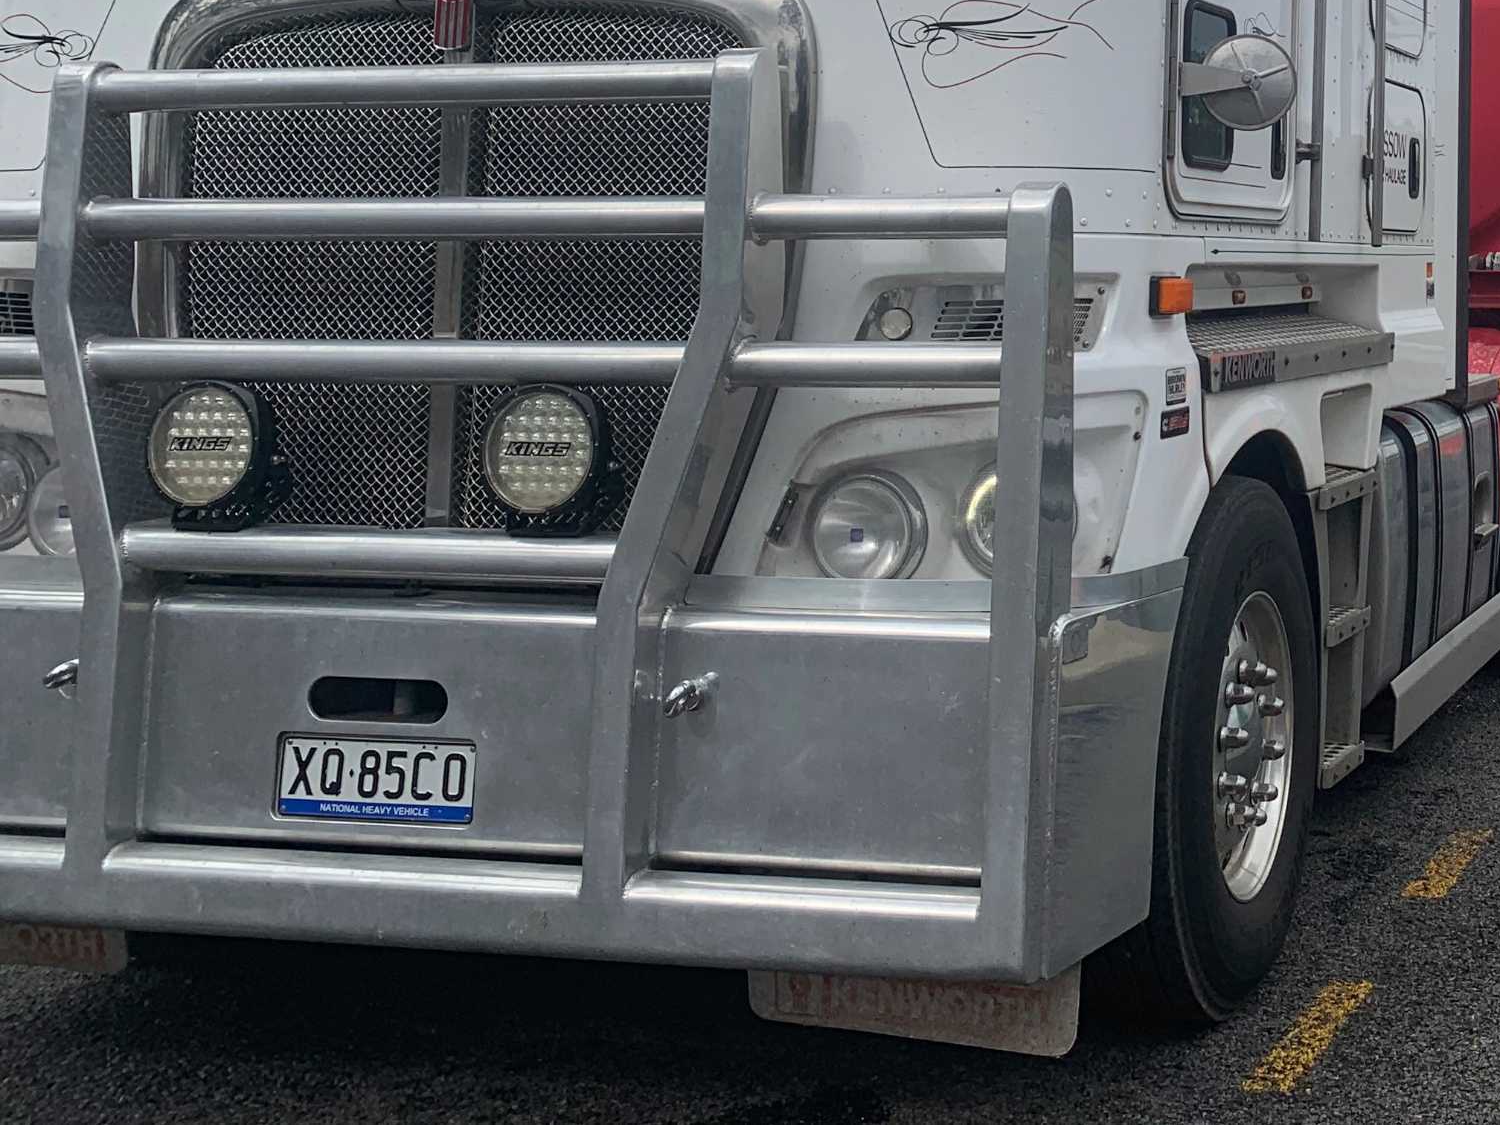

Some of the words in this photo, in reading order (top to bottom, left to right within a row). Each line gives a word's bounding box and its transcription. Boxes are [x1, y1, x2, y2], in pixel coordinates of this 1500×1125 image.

[1383, 130, 1407, 159] SSOW
[1384, 167, 1407, 186] HAULAGE
[1224, 351, 1279, 383] KENWORTH
[168, 435, 233, 451] KINGS
[504, 441, 572, 457] KINGS
[320, 803, 361, 814] NATIONAL
[361, 805, 393, 815] HEAVY
[393, 806, 430, 817] VEHICLE
